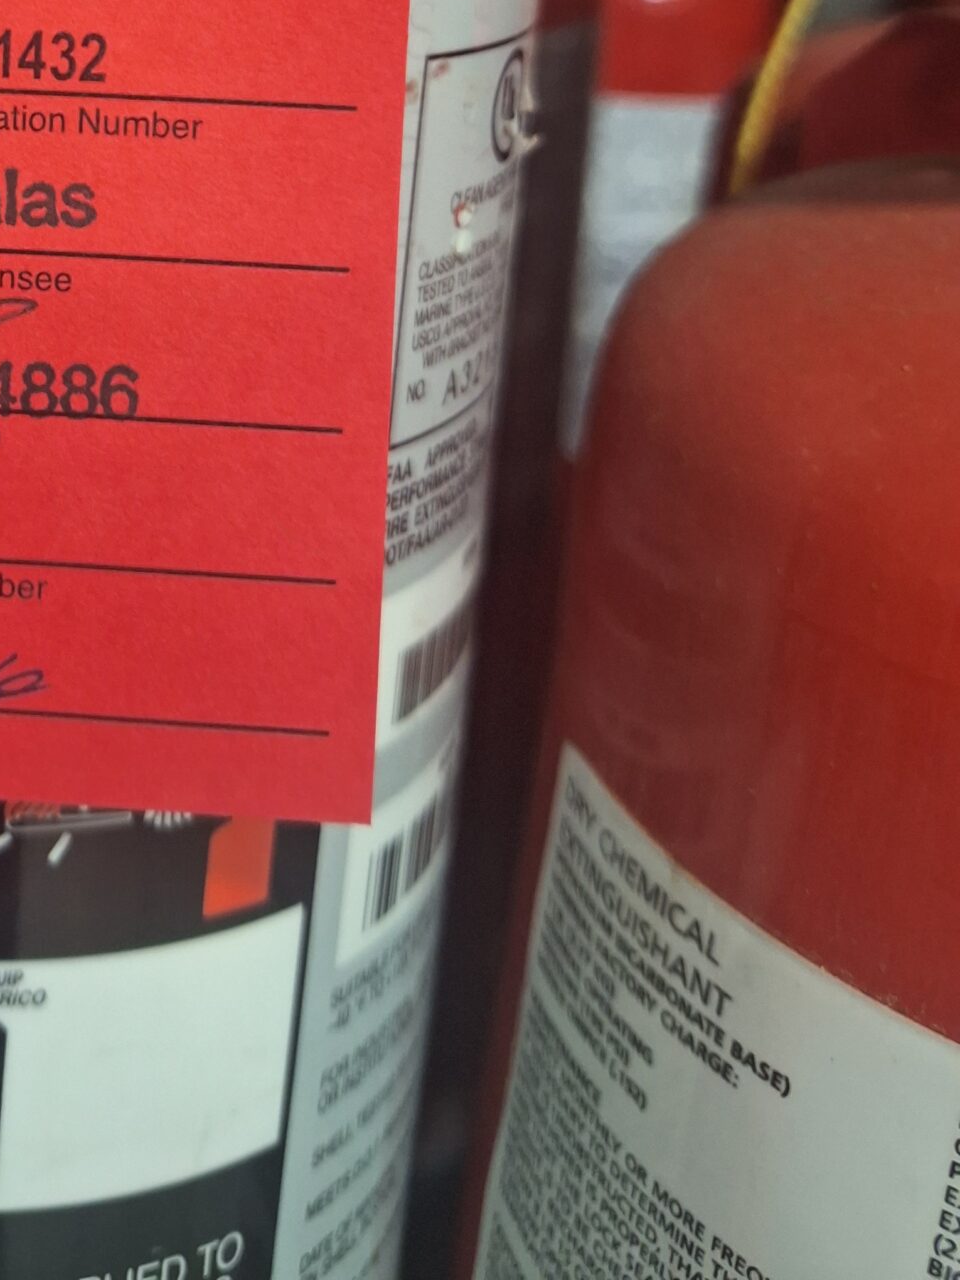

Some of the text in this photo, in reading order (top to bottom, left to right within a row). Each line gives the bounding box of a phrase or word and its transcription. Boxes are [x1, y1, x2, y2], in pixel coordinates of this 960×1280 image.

[77, 110, 203, 141] Number
[598, 827, 721, 968] CHEMICAL
[659, 1008, 741, 1091] CHARGE:
[729, 1038, 793, 1100] BASE)
[651, 1179, 707, 1243] MORE
[196, 1230, 245, 1279] TO
